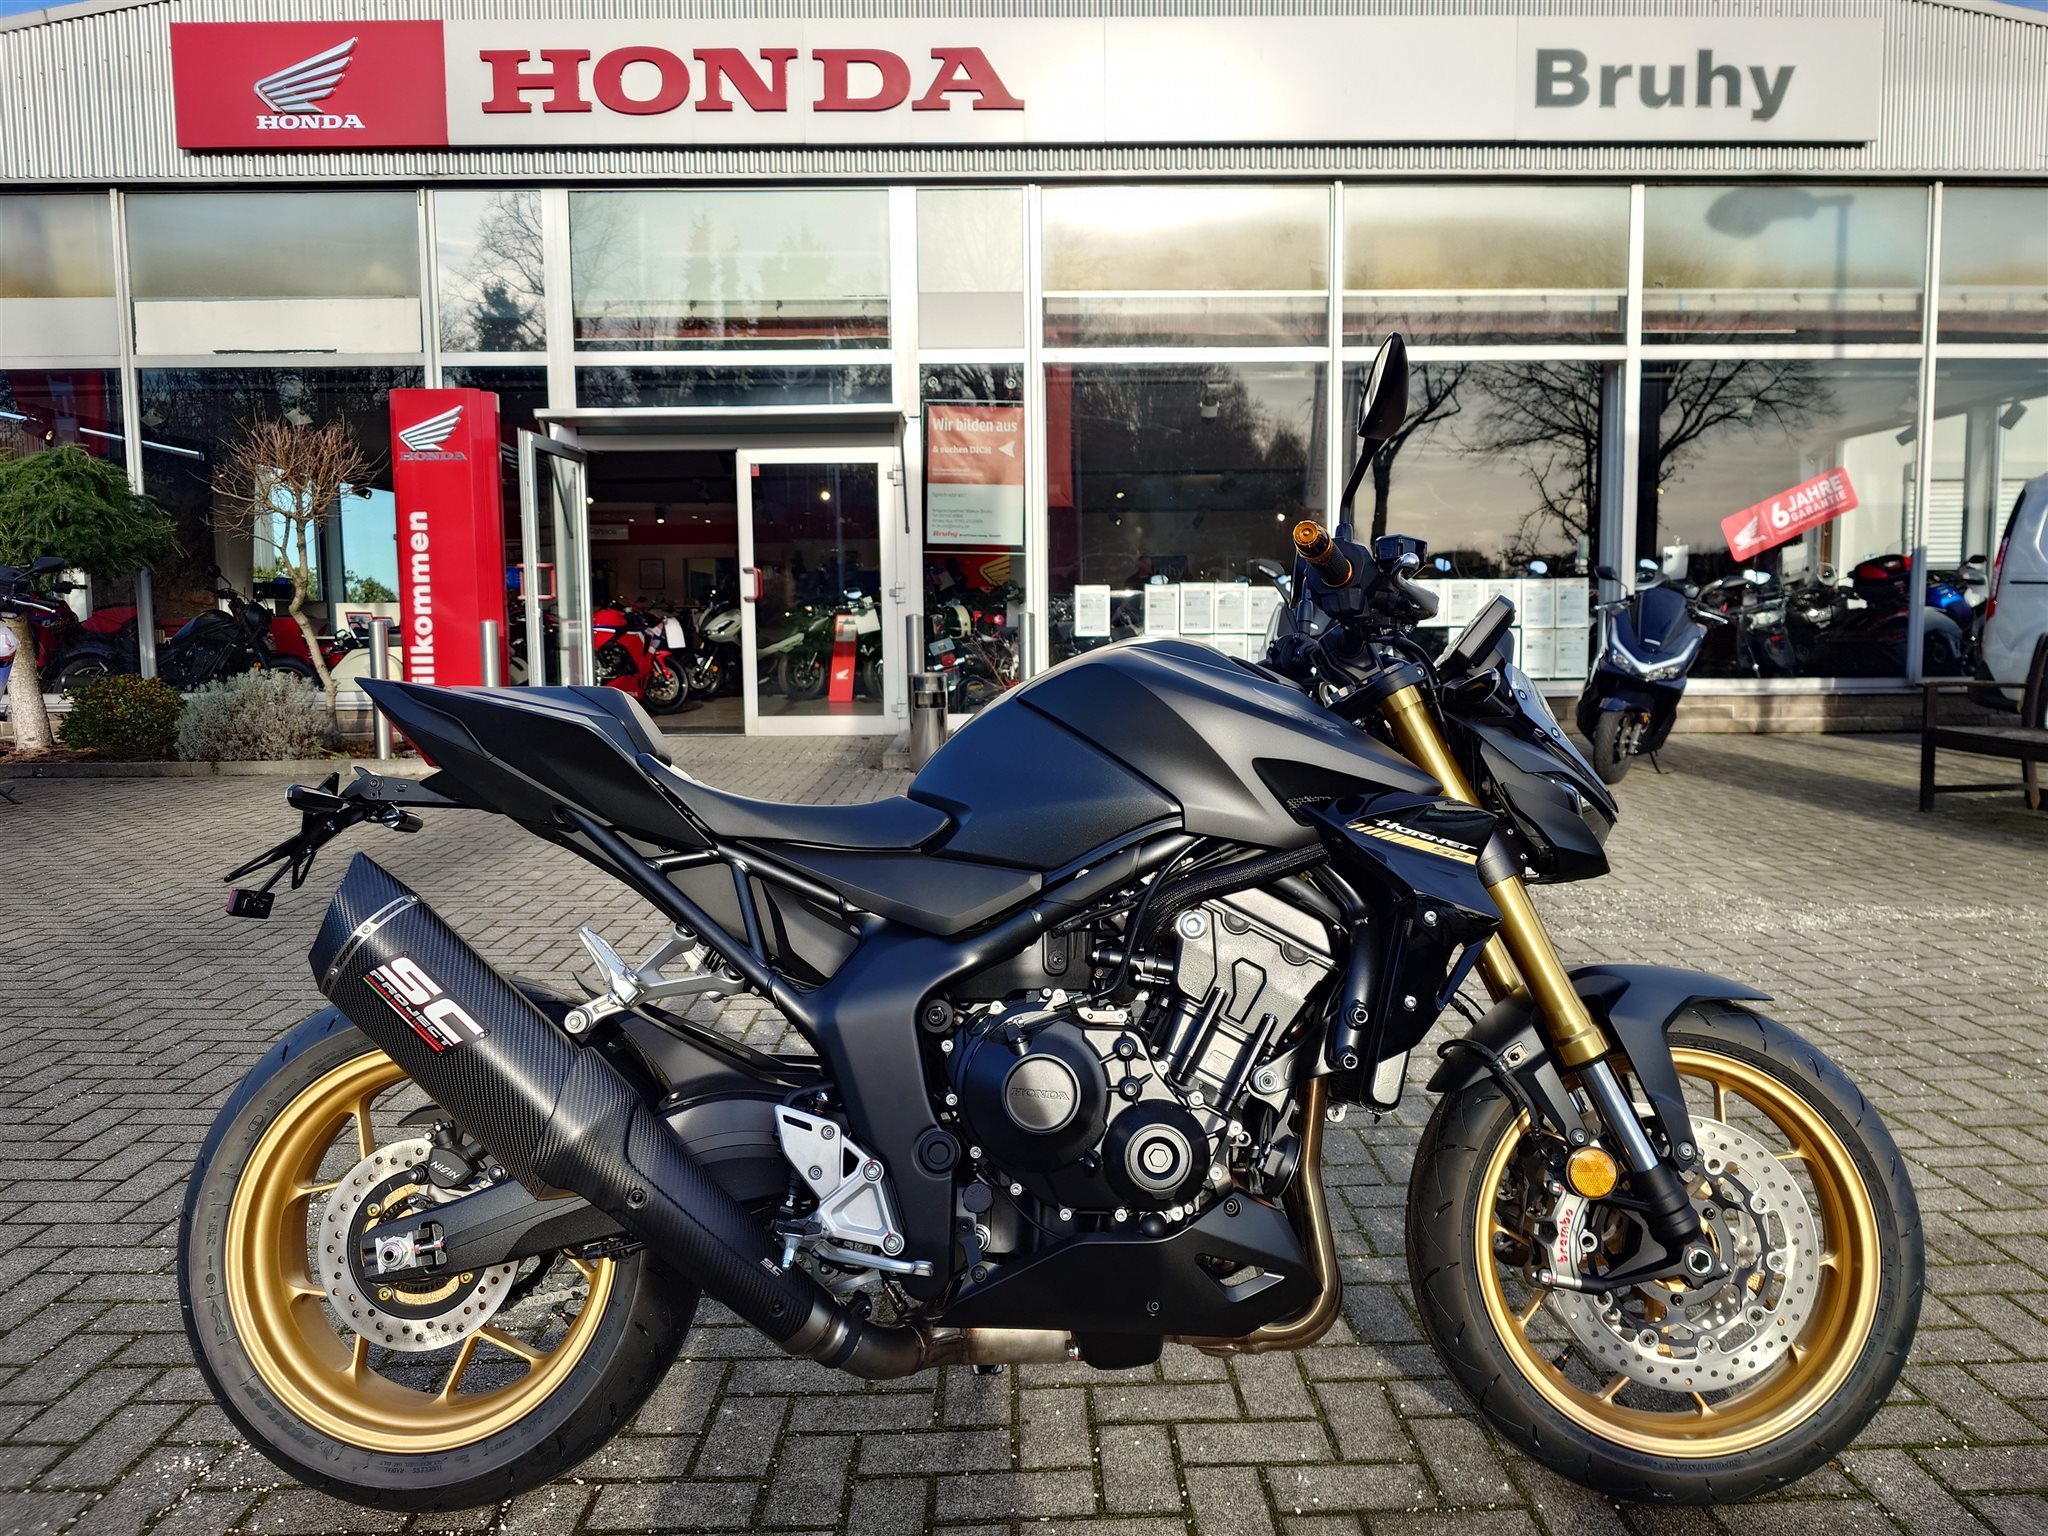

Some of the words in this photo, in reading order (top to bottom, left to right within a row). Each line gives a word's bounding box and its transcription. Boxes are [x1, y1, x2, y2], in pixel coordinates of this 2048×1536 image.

[480, 46, 1025, 114] HONDA
[1535, 48, 1796, 121] Bruhy
[256, 114, 365, 130] HONDA
[933, 418, 955, 432] Wir
[956, 418, 993, 433] bilden
[996, 421, 1018, 433] aus
[940, 446, 968, 454] suchen
[969, 446, 992, 455] DICH
[400, 451, 467, 461] HONDA
[1772, 501, 1791, 529] 6
[1789, 475, 1844, 512] JAHRE
[1790, 490, 1848, 522] GARANTIE
[409, 510, 435, 685] illkommen
[364, 973, 391, 1000] ADVANCED
[390, 998, 413, 1020] EXHAUST
[411, 1019, 445, 1052] TECHNOLOGY
[368, 969, 454, 1048] PROJECT
[376, 957, 485, 1045] SC
[1011, 1087, 1070, 1101] HONDA
[1556, 1208, 1574, 1264] brembo
